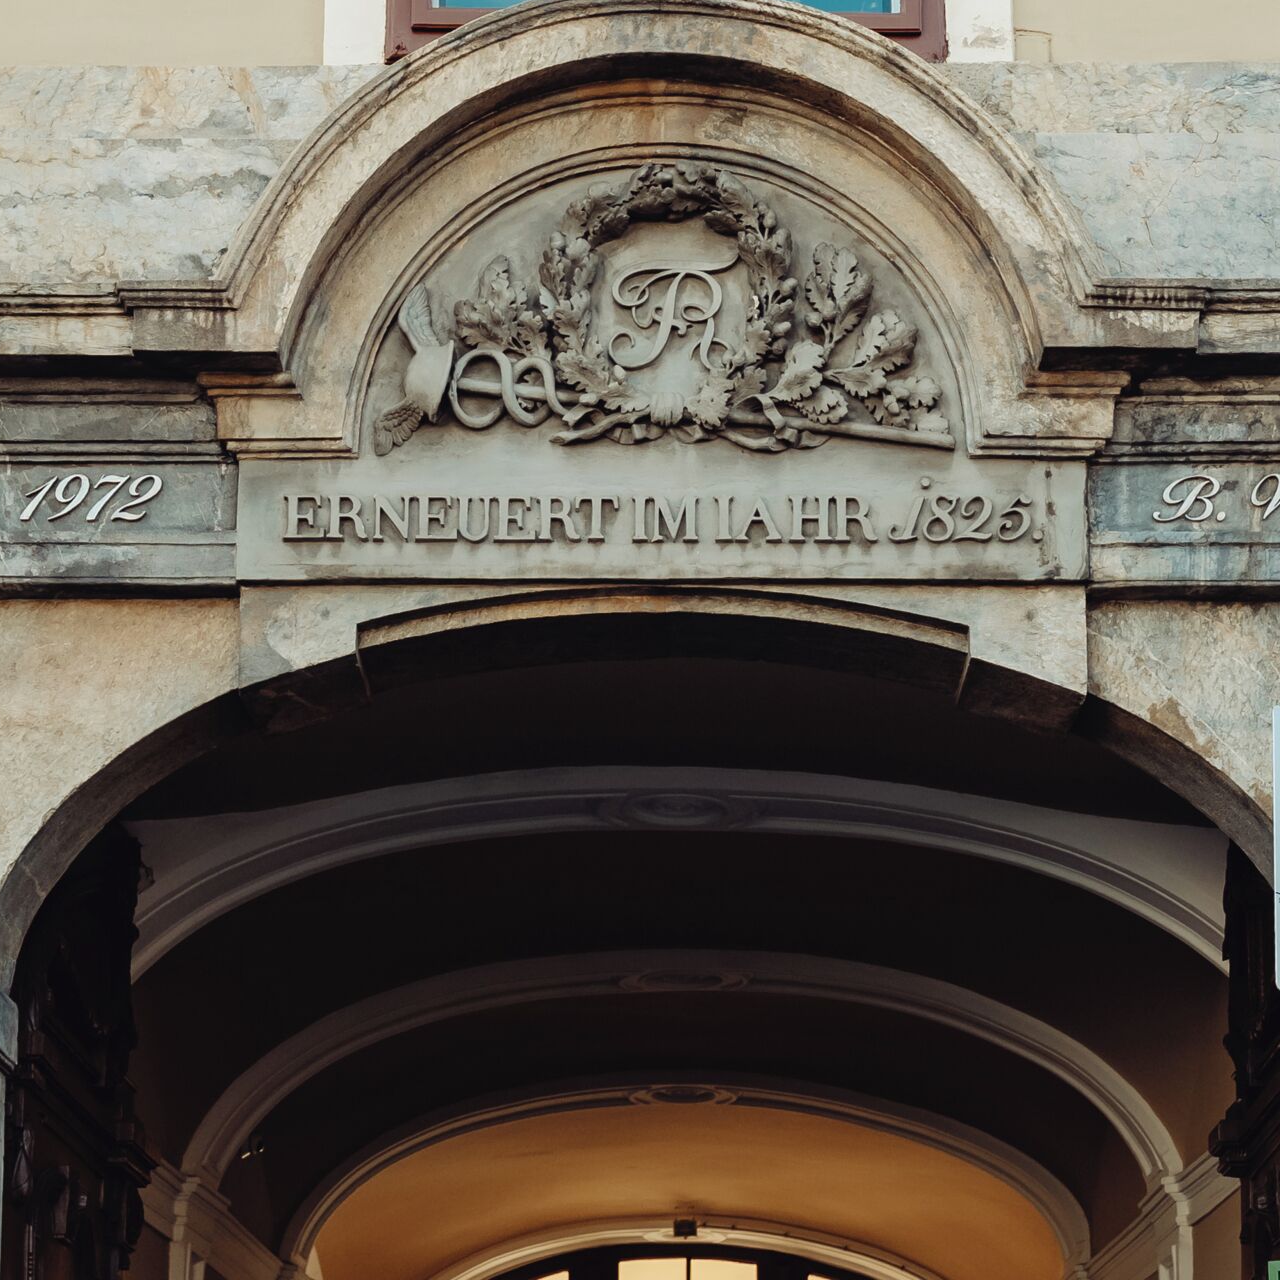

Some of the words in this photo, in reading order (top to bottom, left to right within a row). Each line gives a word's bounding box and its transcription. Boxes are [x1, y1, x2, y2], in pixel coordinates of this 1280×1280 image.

[20, 474, 163, 521] 1972
[282, 494, 620, 542] ERNEUERT
[632, 495, 699, 543] IM
[1153, 473, 1226, 522] B.
